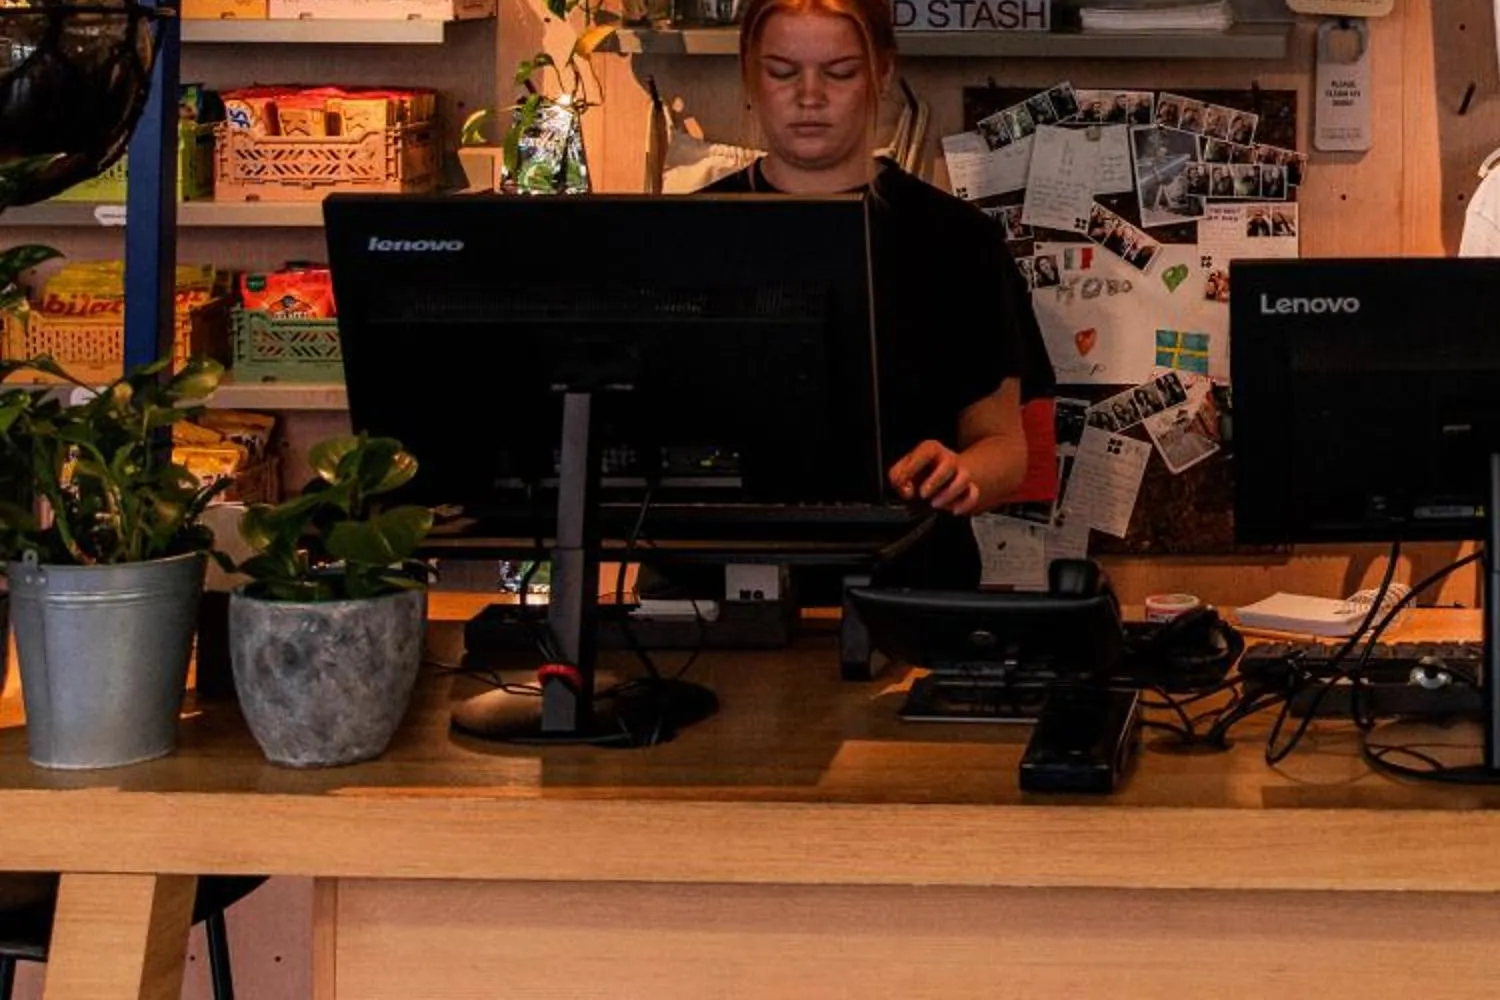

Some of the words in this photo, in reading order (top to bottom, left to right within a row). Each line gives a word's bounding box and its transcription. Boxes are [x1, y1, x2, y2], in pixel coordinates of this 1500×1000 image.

[927, 0, 1047, 29] STASH
[367, 236, 465, 252] lenovo
[1259, 292, 1361, 315] Lenovo
